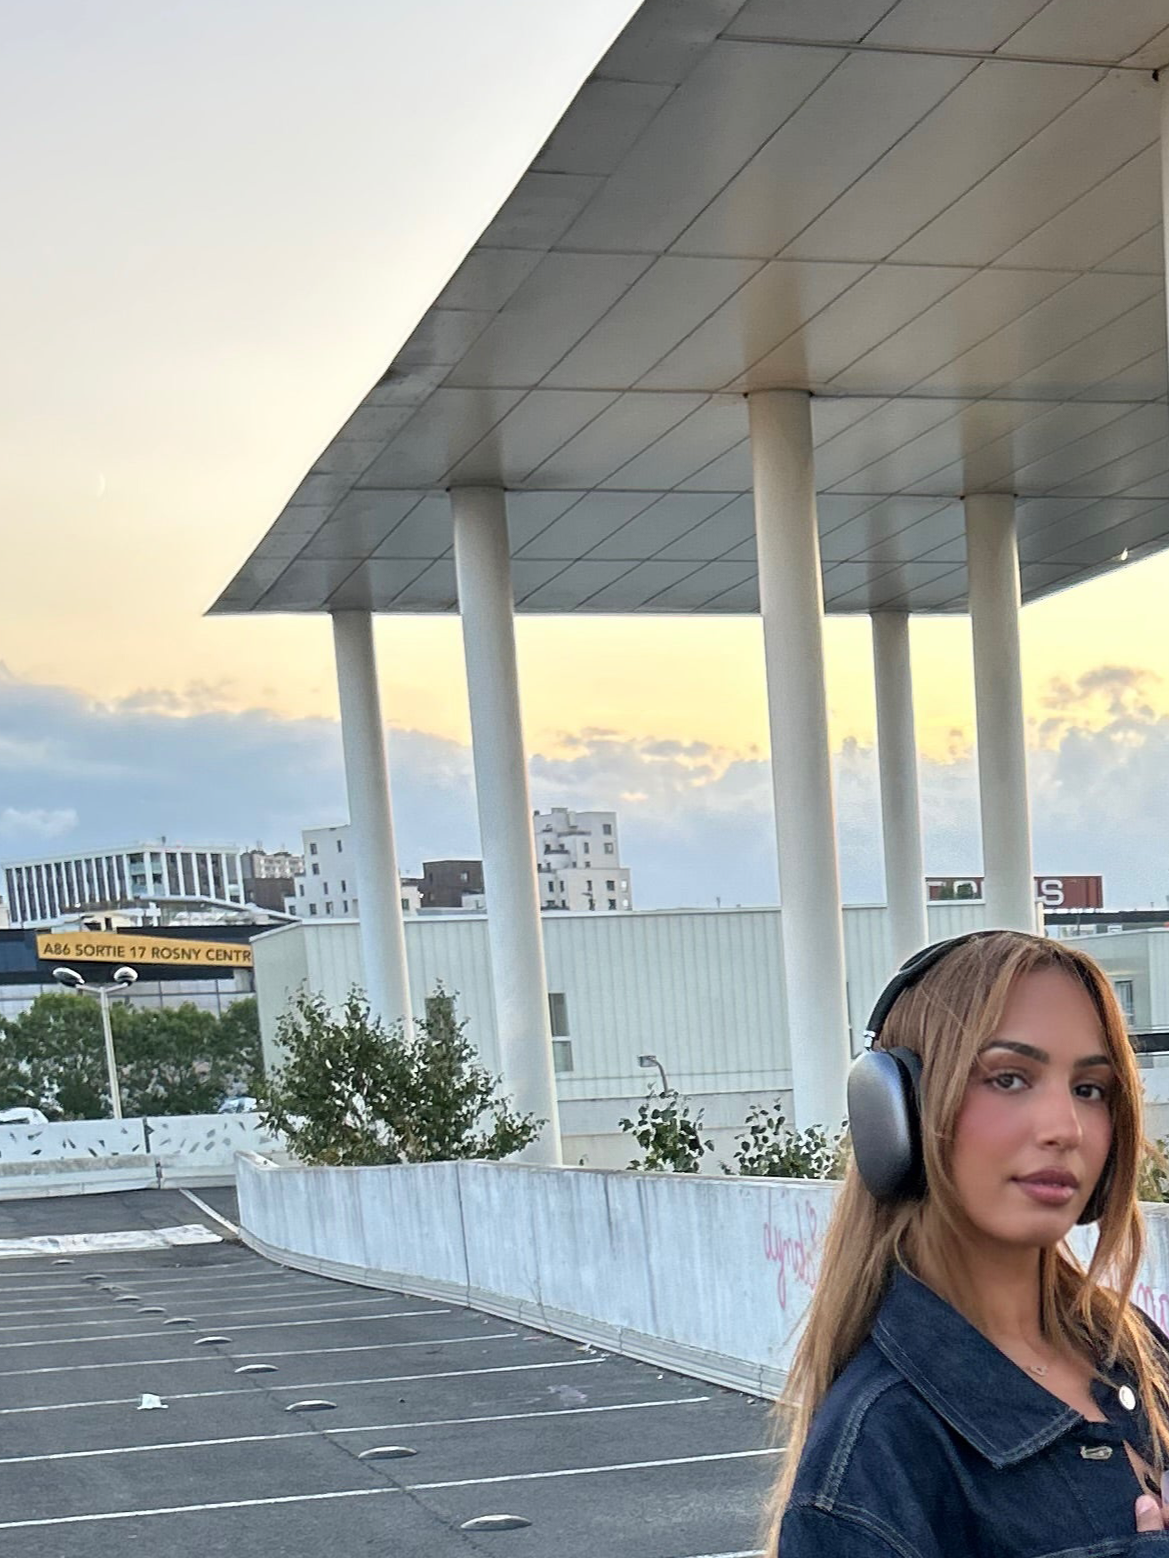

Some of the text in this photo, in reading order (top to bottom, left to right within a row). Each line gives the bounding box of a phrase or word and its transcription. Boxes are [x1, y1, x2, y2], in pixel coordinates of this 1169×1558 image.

[43, 943, 71, 956] A86
[75, 944, 125, 958] SORTIE
[129, 946, 146, 958] 17
[151, 946, 202, 961] ROSNY
